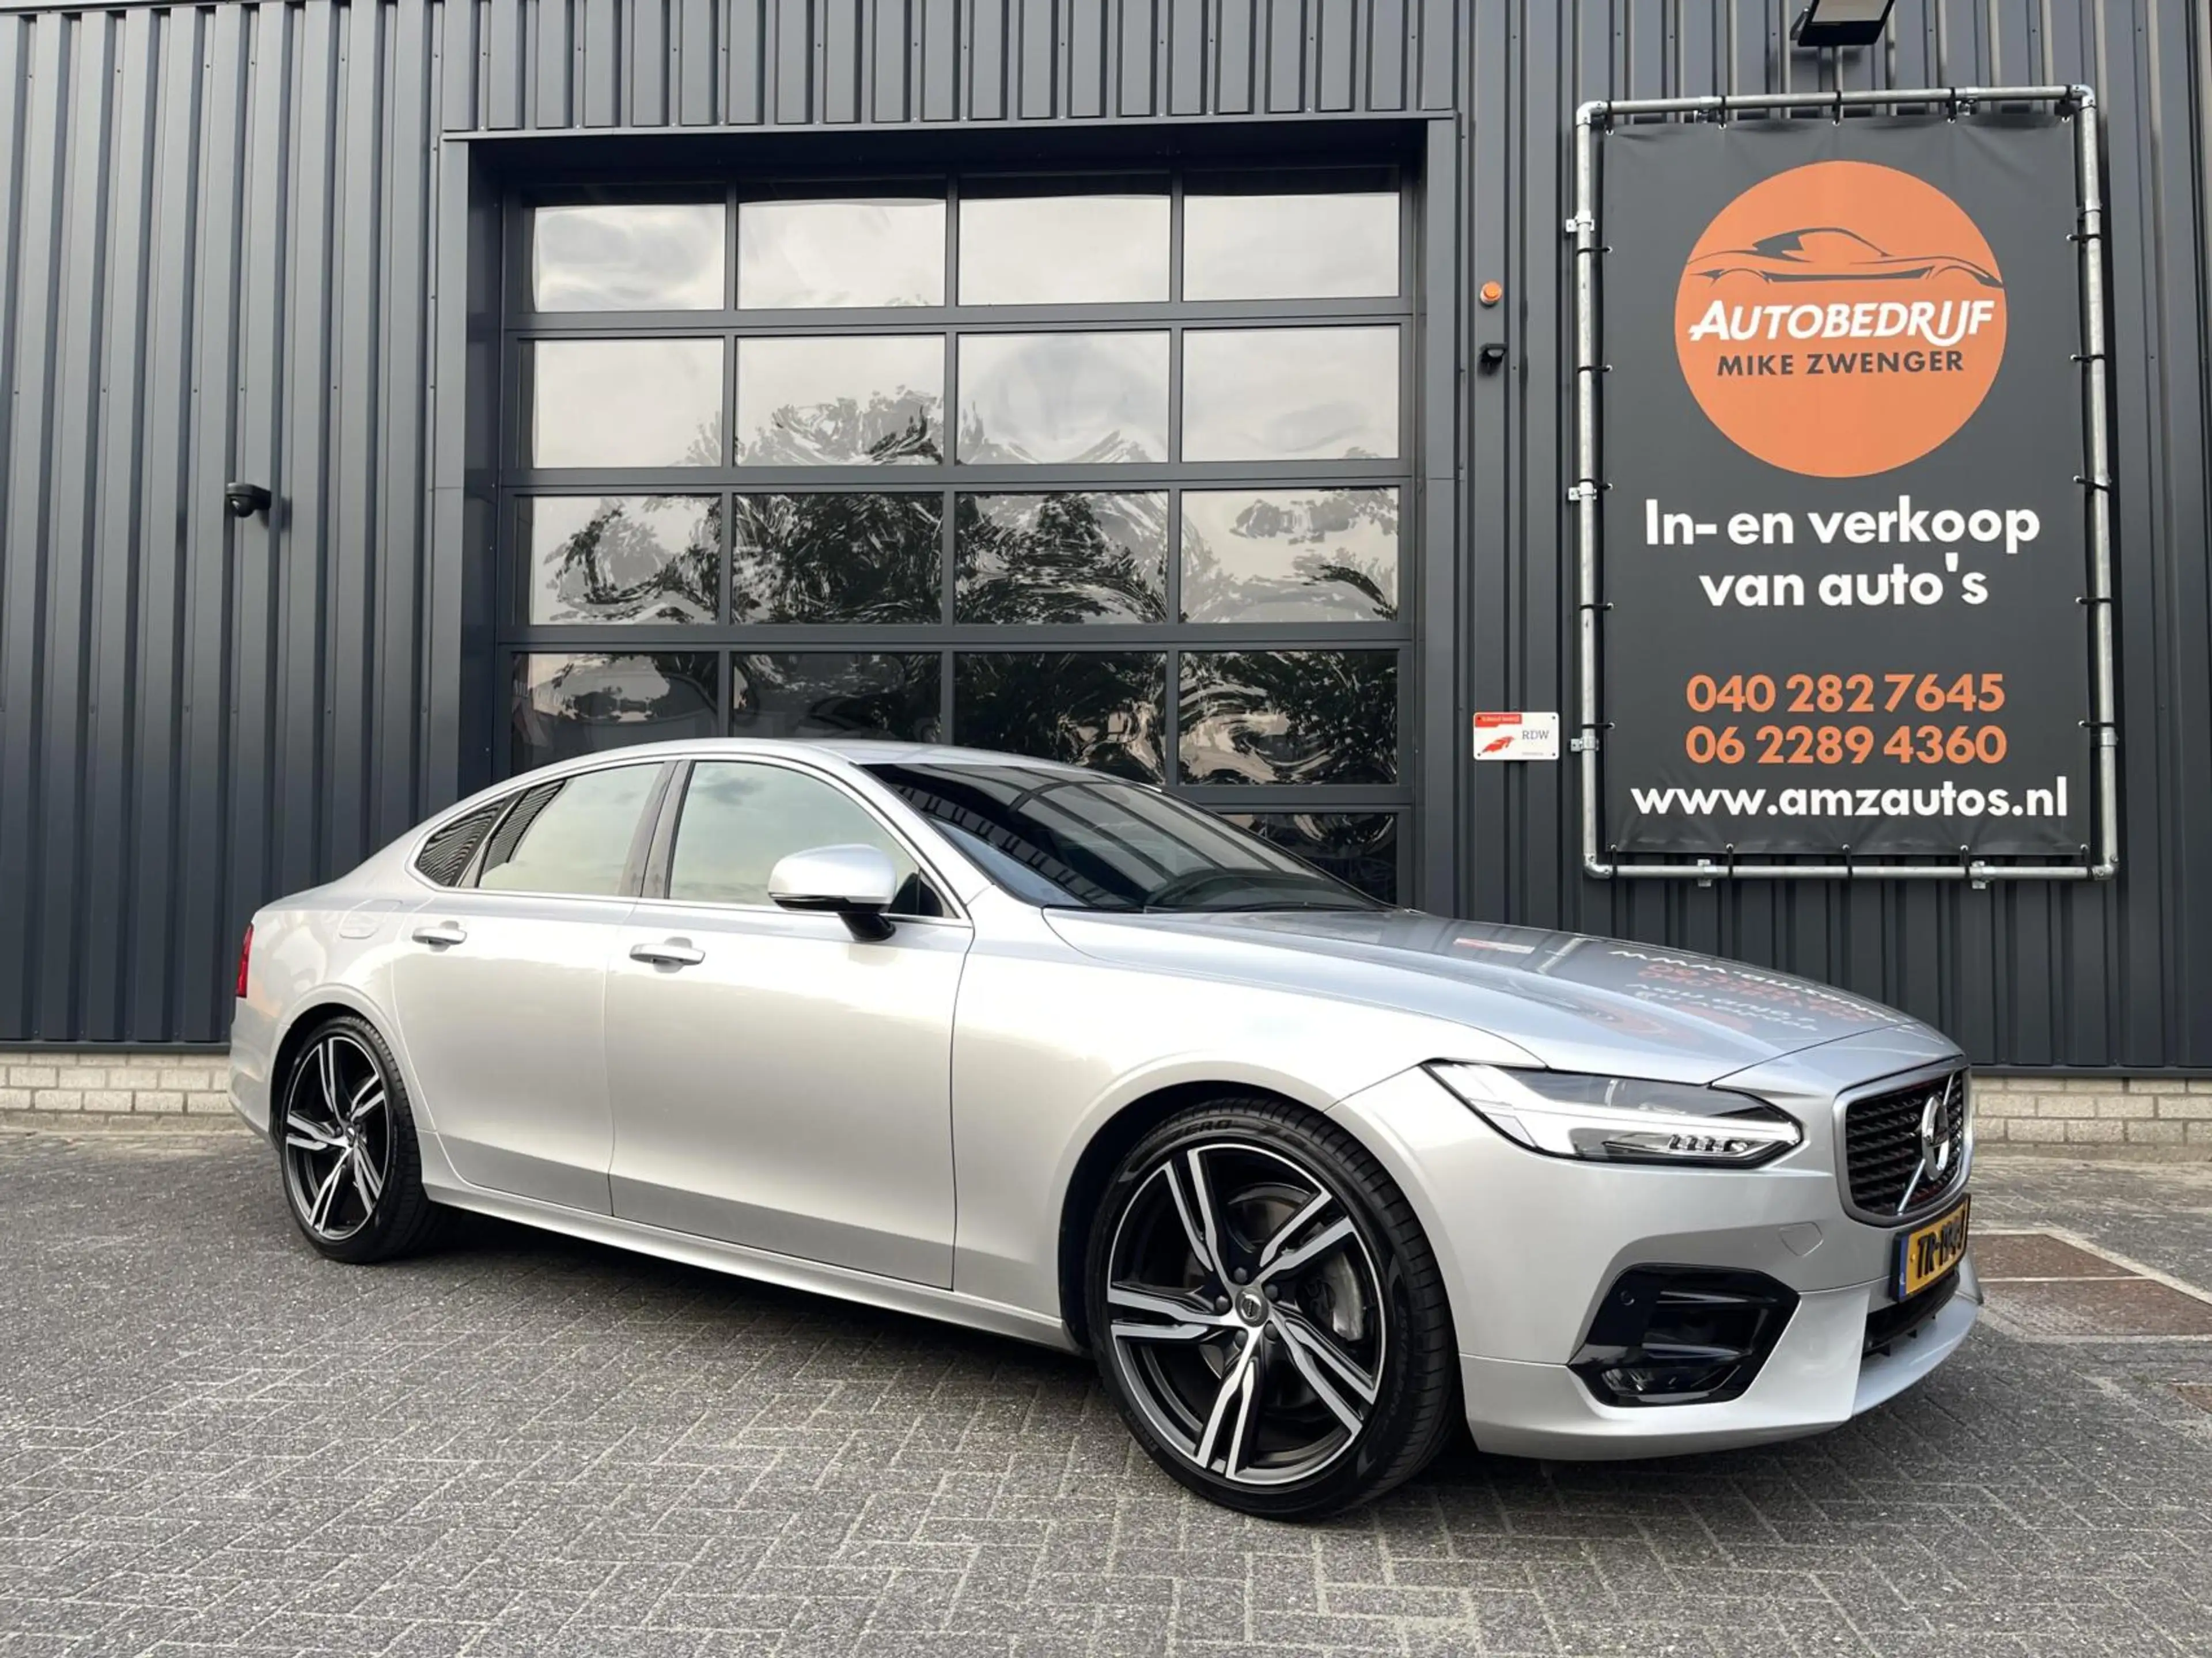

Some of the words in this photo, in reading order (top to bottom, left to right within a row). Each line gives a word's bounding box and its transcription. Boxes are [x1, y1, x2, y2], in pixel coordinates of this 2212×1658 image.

[1717, 354, 1793, 376] MIKE
[1806, 350, 1964, 374] ZWENGER
[1645, 499, 1718, 545] In-
[1726, 511, 1794, 545] en
[1806, 494, 2041, 555] verkoop
[1698, 574, 1805, 608] van
[1817, 552, 1989, 607] auto's
[1685, 673, 1776, 713] 040
[1786, 673, 1873, 713] 282
[1885, 672, 2005, 712] 7645
[1522, 730, 1549, 739] RDW
[1685, 724, 1745, 765] 06
[1756, 724, 1874, 764] 2289
[1883, 724, 2008, 765] 4360
[1630, 775, 2068, 817] www.amzautos.nl
